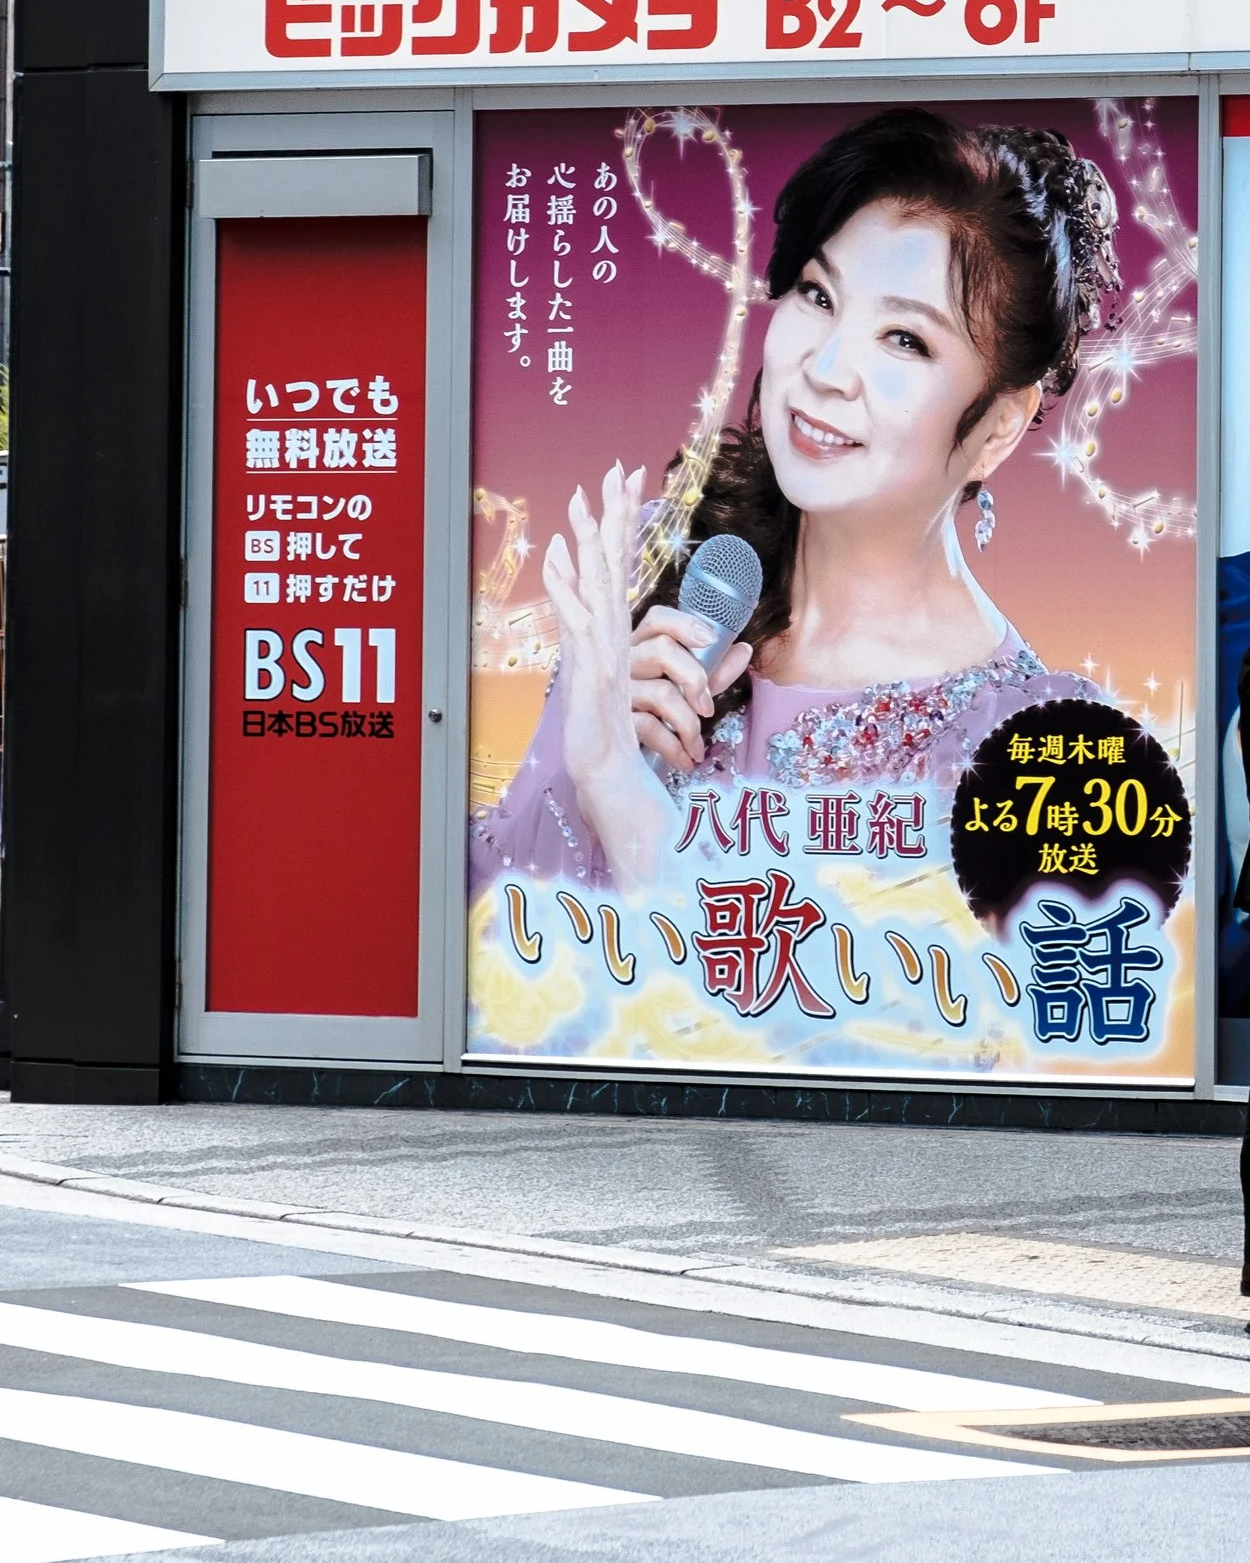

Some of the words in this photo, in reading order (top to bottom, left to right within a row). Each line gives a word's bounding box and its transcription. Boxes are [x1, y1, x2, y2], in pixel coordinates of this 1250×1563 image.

[590, 161, 620, 284] あの人の
[503, 162, 533, 368] お届けします。
[546, 162, 577, 406] 心揺らした一曲を
[246, 374, 400, 415] いつでも
[245, 427, 398, 469] 無料放送
[246, 493, 373, 522] リモコンの
[250, 538, 274, 554] BS
[286, 531, 364, 562] 押して
[252, 580, 271, 597] 11
[286, 573, 397, 603] 押すだけ
[243, 626, 397, 704] BS11
[242, 710, 395, 739] 日本BS放送
[1006, 732, 1127, 766] 毎週木曜
[964, 775, 1184, 839] よる7時30分
[1037, 842, 1100, 876] 放送
[505, 868, 1163, 1045] いい歌いい話
